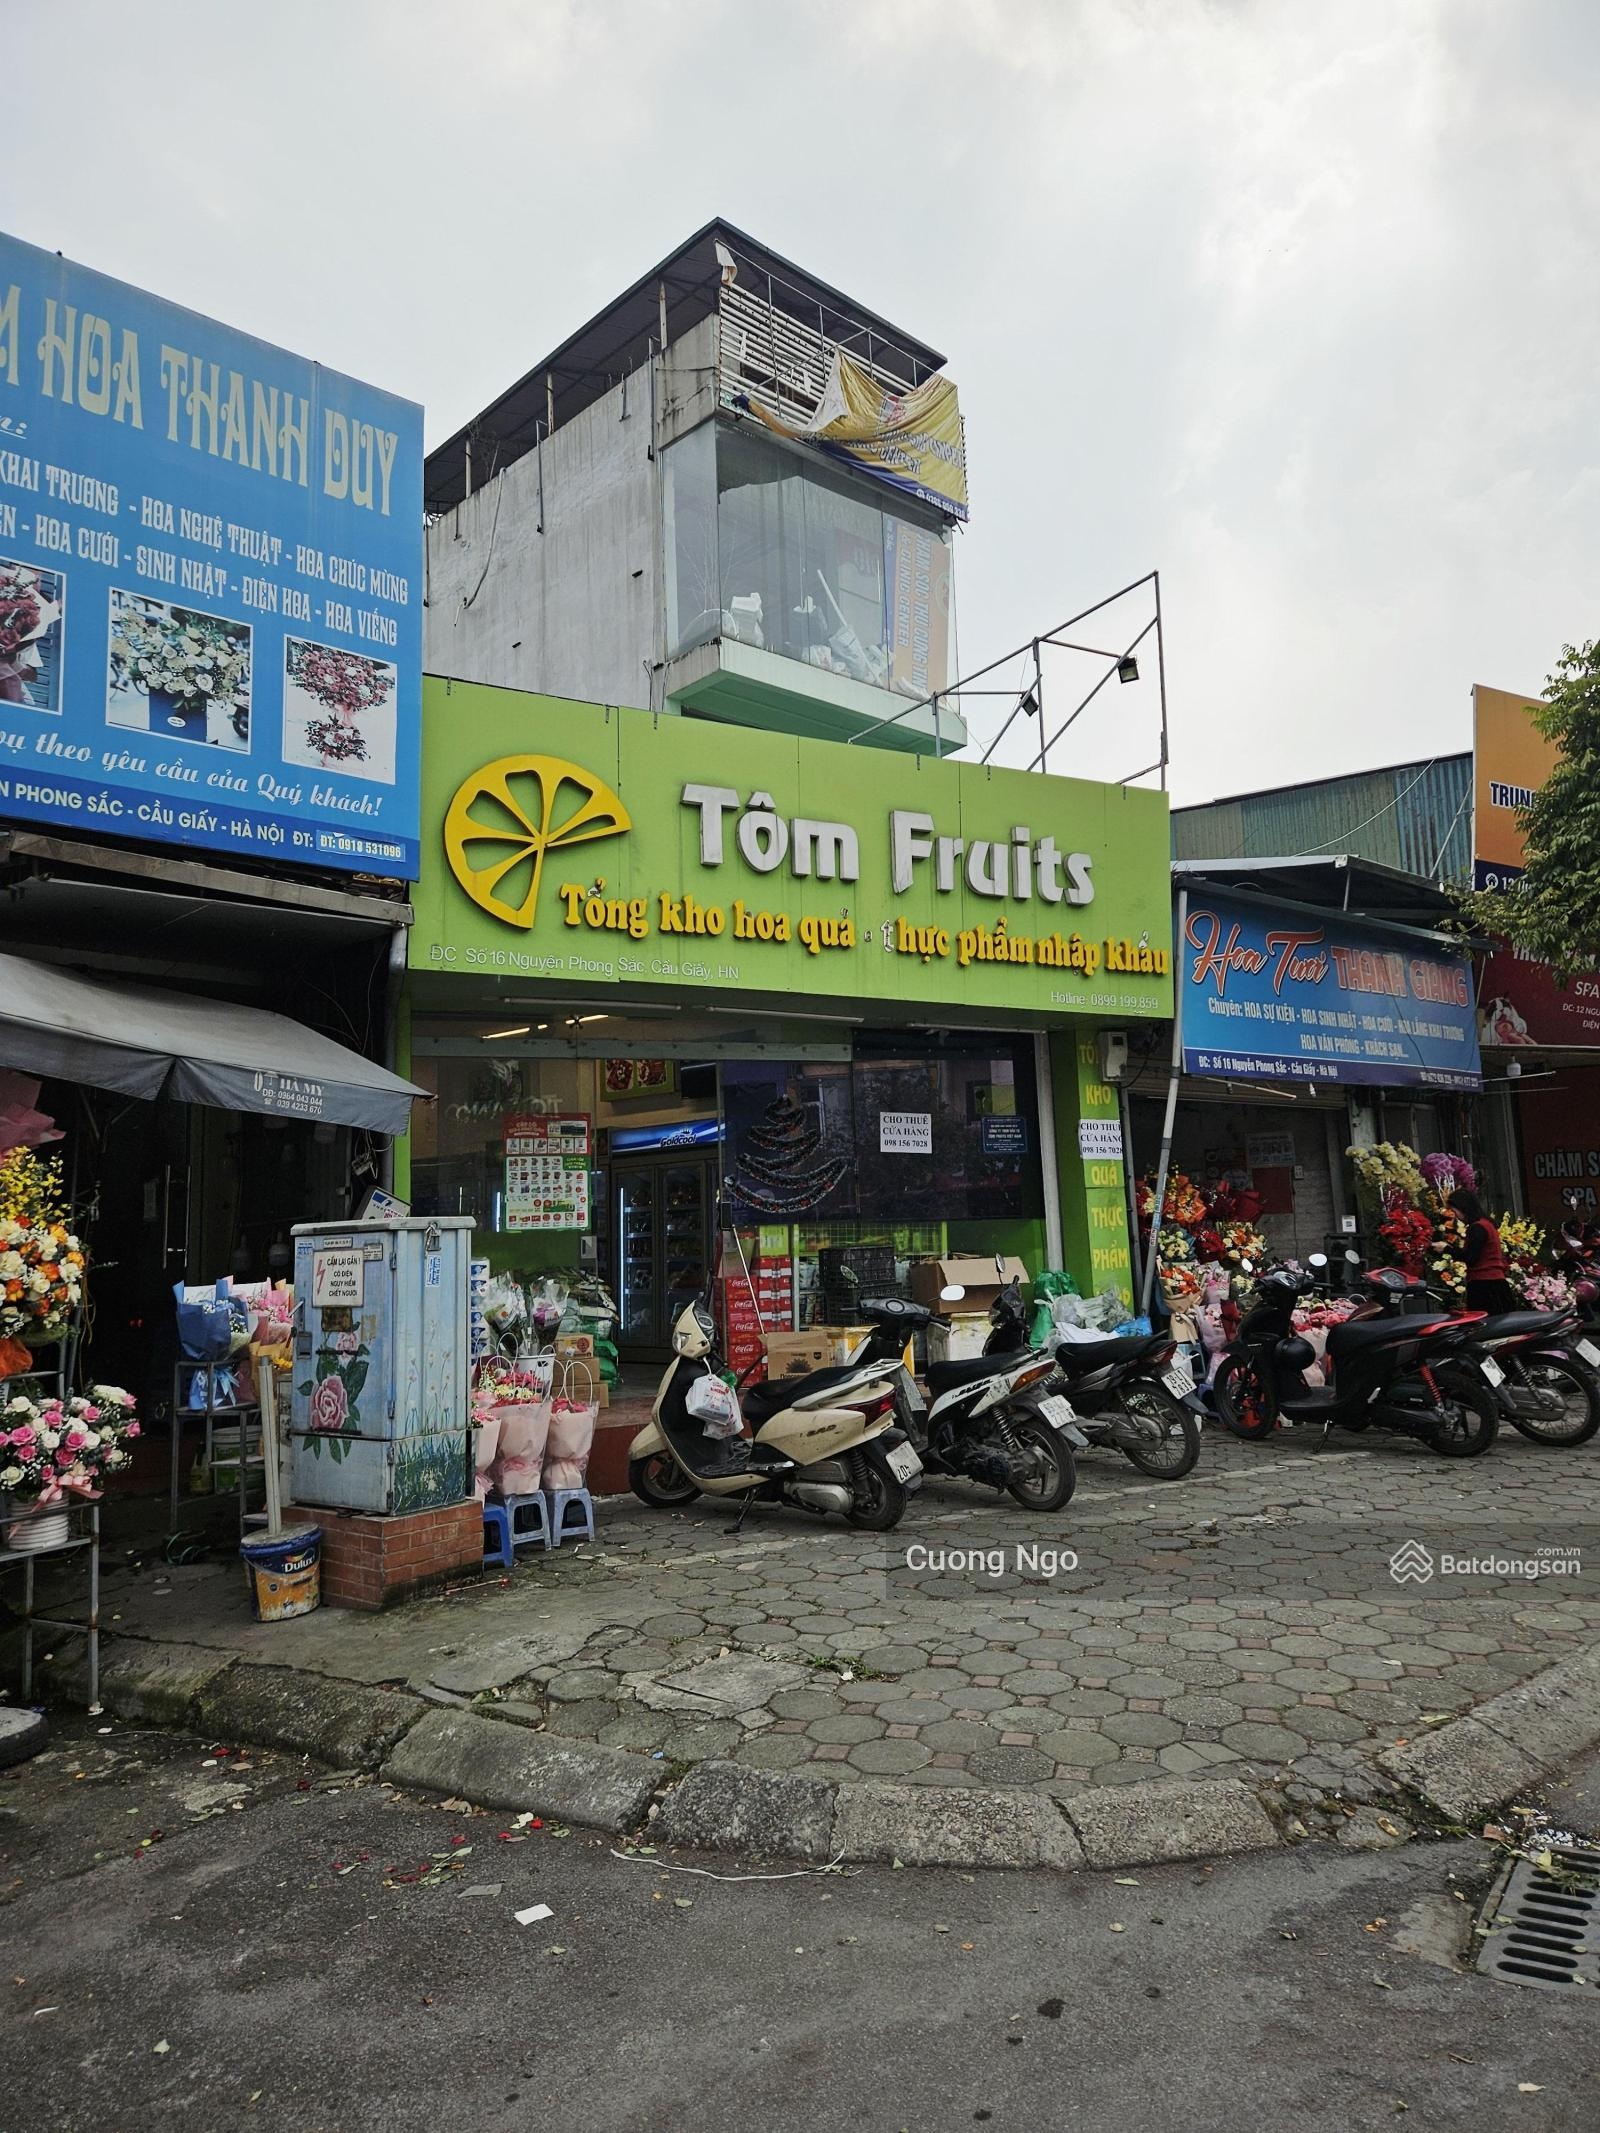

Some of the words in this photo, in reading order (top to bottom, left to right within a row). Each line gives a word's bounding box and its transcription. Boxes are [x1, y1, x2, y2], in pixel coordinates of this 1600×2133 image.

[38, 298, 143, 429] HOA
[160, 344, 308, 487] THANH
[323, 408, 398, 516] DUY
[141, 496, 174, 534] HOA
[180, 508, 223, 553] NGHỆ
[228, 523, 282, 567] THUẬT
[296, 544, 325, 580] HOA
[329, 556, 366, 592] CHÚC
[370, 568, 408, 605] MỪNG
[35, 514, 72, 554] HOA
[78, 526, 119, 570] CƯỚI
[136, 545, 176, 586] SINH
[181, 558, 228, 600] NHẬT
[241, 576, 278, 613] ĐIỆN
[282, 588, 311, 622] HOA
[326, 600, 353, 634] HOA
[358, 608, 397, 646] VIẾNG
[35, 733, 93, 762] theo
[101, 750, 148, 772] yêu
[155, 757, 200, 783] cầu
[207, 768, 249, 792] của
[257, 773, 304, 806] Quý
[310, 784, 383, 817] khách!
[1490, 781, 1536, 808] TRUN
[16, 783, 83, 809] PHONG
[87, 790, 124, 817] SẮC
[138, 799, 173, 825] CẦU
[179, 809, 218, 832] GIẤY
[231, 818, 252, 838] HÀ
[257, 823, 284, 846] NỘI
[293, 831, 314, 848] ĐT:
[320, 834, 336, 849] ĐT:
[338, 839, 363, 853] 0918
[366, 842, 401, 858] 531096
[680, 783, 860, 881] Tôm
[889, 809, 1095, 907] Fruits
[560, 877, 649, 939] Tổng
[659, 892, 725, 936] kho
[733, 899, 792, 943] hoa
[799, 906, 856, 955] quả
[957, 916, 1033, 966] phẩm
[1037, 932, 1100, 976] nhập
[1105, 930, 1169, 974] khẩu
[431, 945, 457, 961] ĐC
[465, 947, 488, 963] Số
[490, 950, 505, 965] 16
[569, 956, 613, 976] Phong
[718, 966, 739, 979] HN
[1185, 910, 1268, 997] Hoa
[1331, 946, 1408, 998] THANH
[1409, 960, 1470, 1009] GIANG
[1091, 993, 1116, 1007] 0899
[1208, 997, 1243, 1017] Chuyên:
[1244, 1001, 1263, 1019] HOA
[1263, 1003, 1274, 1024] SỰ
[1276, 1003, 1295, 1025] KIỆN
[1301, 1008, 1317, 1025] HOA
[1318, 1011, 1336, 1027] SINH
[1337, 1010, 1356, 1032] NHẬT
[1362, 1015, 1377, 1031] HOA
[1300, 1034, 1317, 1050] HOA
[1318, 1034, 1334, 1051] VĂN
[1335, 1034, 1360, 1055] PHÒNG
[1365, 1039, 1388, 1056] KHÁCH
[1199, 1056, 1210, 1068] ĐC:
[1213, 1056, 1222, 1069] Số
[1223, 1058, 1231, 1069] 16
[1256, 1060, 1275, 1073] Phong
[278, 1091, 294, 1101] 0964
[296, 1094, 308, 1104] 043
[310, 1097, 323, 1106] 044
[303, 1083, 325, 1097] MY
[1086, 1085, 1111, 1106] KHO
[277, 1100, 290, 1109] 039
[291, 1103, 308, 1112] 4233
[309, 1106, 322, 1115] 670
[883, 1116, 902, 1124] CHO
[904, 1115, 929, 1125] THUÊ
[883, 1126, 901, 1136] CỬA
[904, 1127, 929, 1137] HÀNG
[1080, 1123, 1099, 1131] CHO
[1080, 1132, 1099, 1142] CỬA
[912, 1140, 928, 1148] 7028
[1091, 1160, 1117, 1187] QUẢ
[1534, 1149, 1584, 1178] CHĂM
[1091, 1206, 1124, 1231] THỰC
[285, 1556, 314, 1573] Dulux
